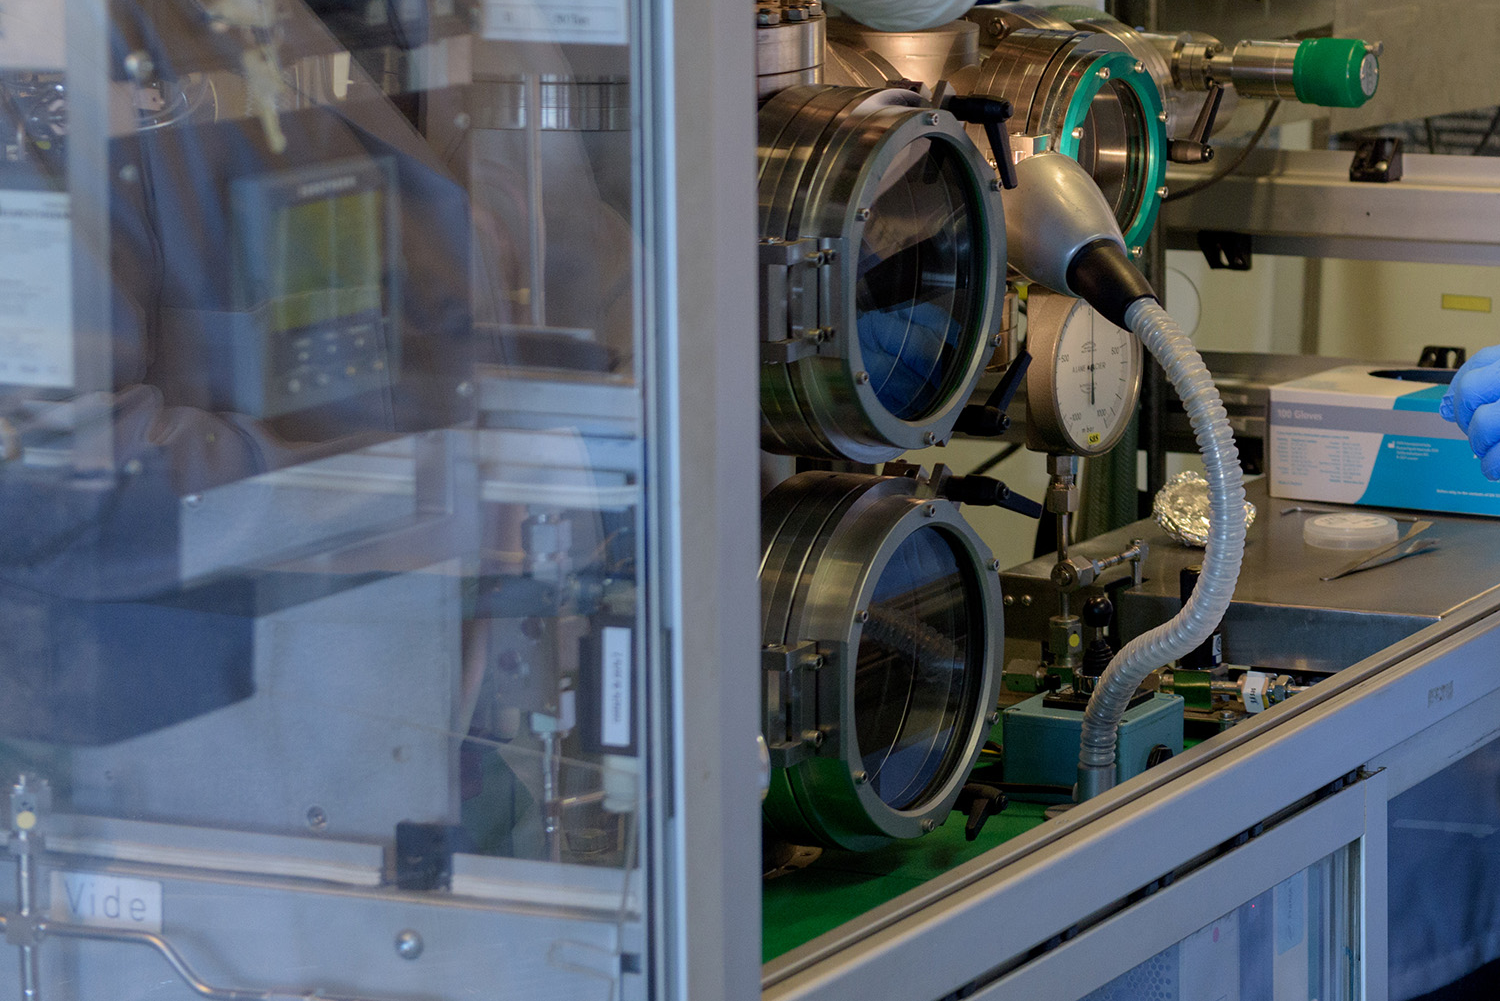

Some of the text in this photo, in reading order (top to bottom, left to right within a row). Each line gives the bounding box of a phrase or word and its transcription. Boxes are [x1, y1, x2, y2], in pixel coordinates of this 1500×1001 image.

[1277, 408, 1323, 421] 100 Gloves
[64, 879, 147, 923] Vide
